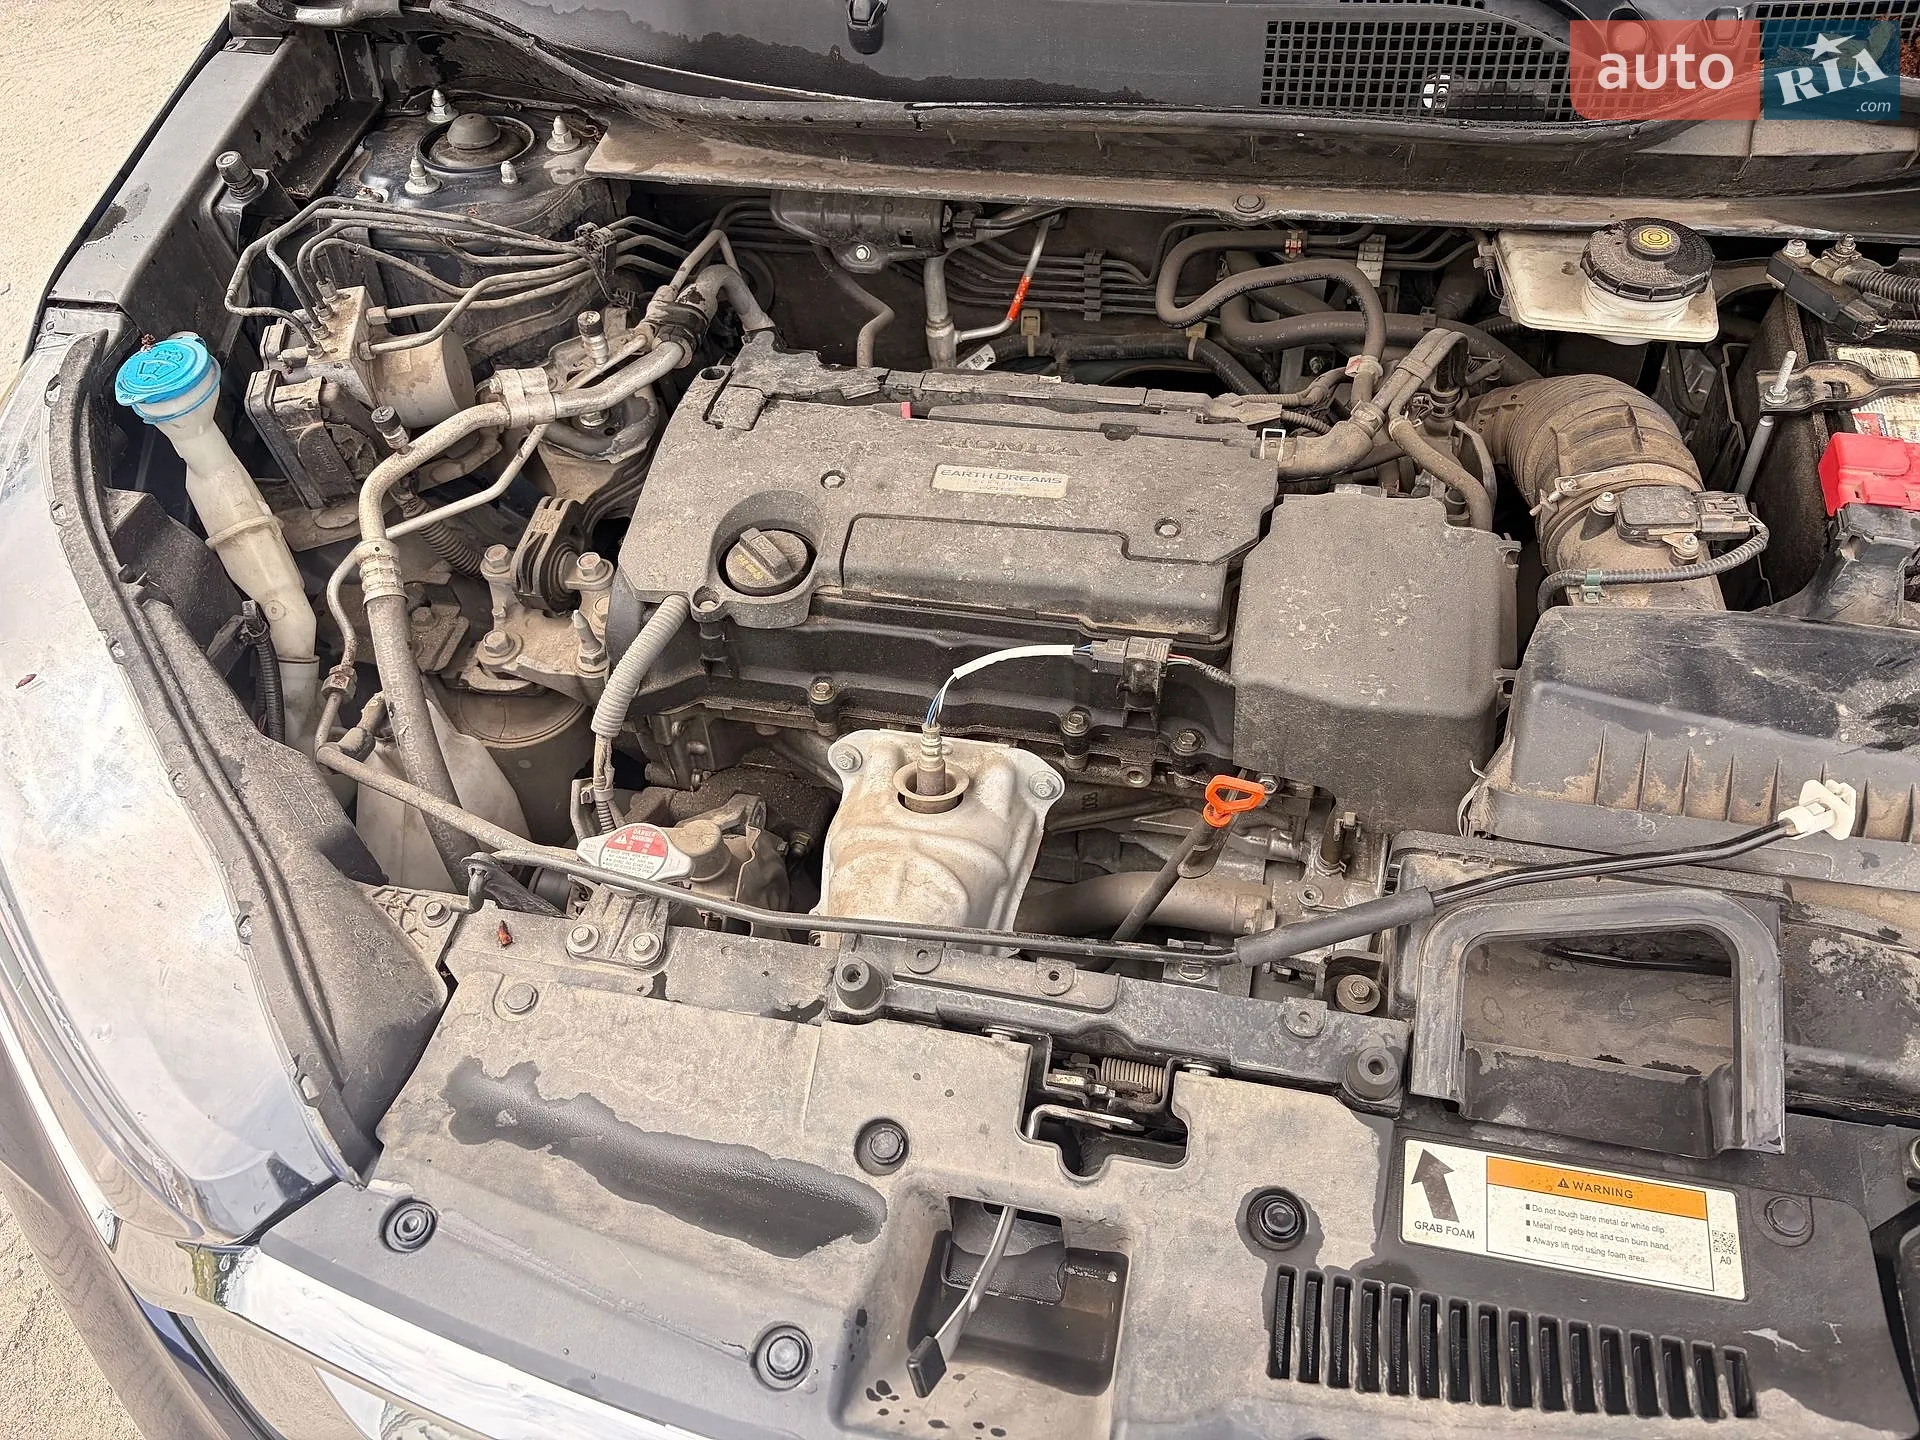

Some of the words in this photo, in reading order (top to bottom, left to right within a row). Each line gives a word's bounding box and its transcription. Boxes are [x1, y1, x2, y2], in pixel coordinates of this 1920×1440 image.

[940, 469, 993, 480] EARTH
[996, 472, 1062, 484] DREAMS
[1572, 1180, 1634, 1199] WARNING
[1532, 1204, 1543, 1213] Do
[1544, 1207, 1557, 1216] not
[1558, 1209, 1578, 1219] touch
[1580, 1213, 1597, 1223] bare
[1598, 1216, 1619, 1226] metal
[1620, 1220, 1629, 1228] or
[1630, 1222, 1650, 1232] white
[1414, 1220, 1444, 1234] GRAB
[1446, 1225, 1476, 1240] FOAM
[1532, 1220, 1553, 1231] Metal
[1554, 1225, 1567, 1233] rod
[1568, 1227, 1585, 1236] gets
[1586, 1230, 1598, 1239] hot
[1599, 1232, 1614, 1241] and
[1615, 1235, 1630, 1244] can
[1631, 1237, 1649, 1248] burn
[1532, 1236, 1559, 1248] Always
[1560, 1241, 1570, 1250] lift
[1571, 1244, 1584, 1253] rod
[1585, 1246, 1606, 1257] using
[1607, 1249, 1627, 1260] foam
